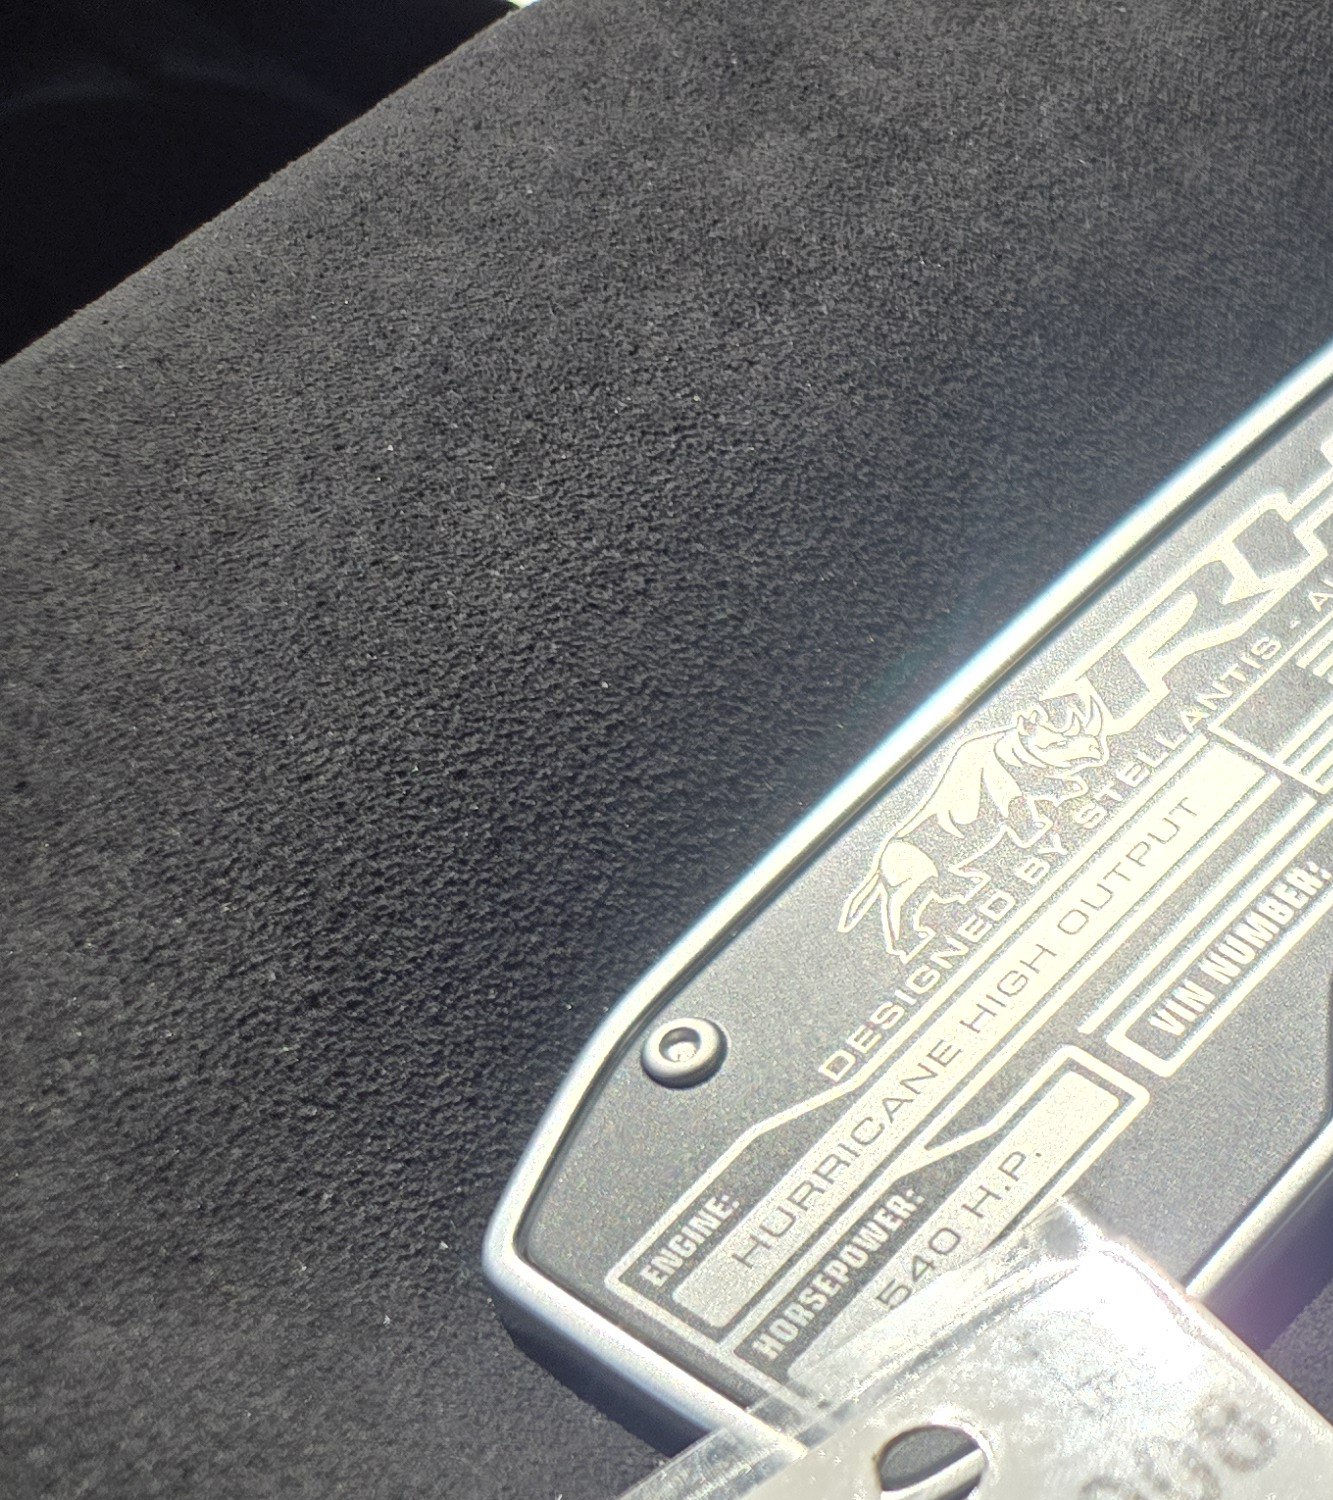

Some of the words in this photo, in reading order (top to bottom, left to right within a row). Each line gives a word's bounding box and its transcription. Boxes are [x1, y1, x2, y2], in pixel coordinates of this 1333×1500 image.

[818, 886, 1018, 1083] DESIGNED
[1015, 830, 1065, 885] BY
[1074, 633, 1285, 830] STELLANTIS
[731, 1037, 963, 1270] HURRICANE
[960, 941, 1057, 1036] HIGH
[1056, 795, 1198, 939] OUTPUT
[1145, 976, 1216, 1036] VIN
[1198, 857, 1333, 990] NUMBER:
[640, 1192, 740, 1287] ENGINE:
[752, 1187, 926, 1359] HORSEPOWER:
[875, 1222, 963, 1311] 540
[963, 1145, 1043, 1219] H.P.
